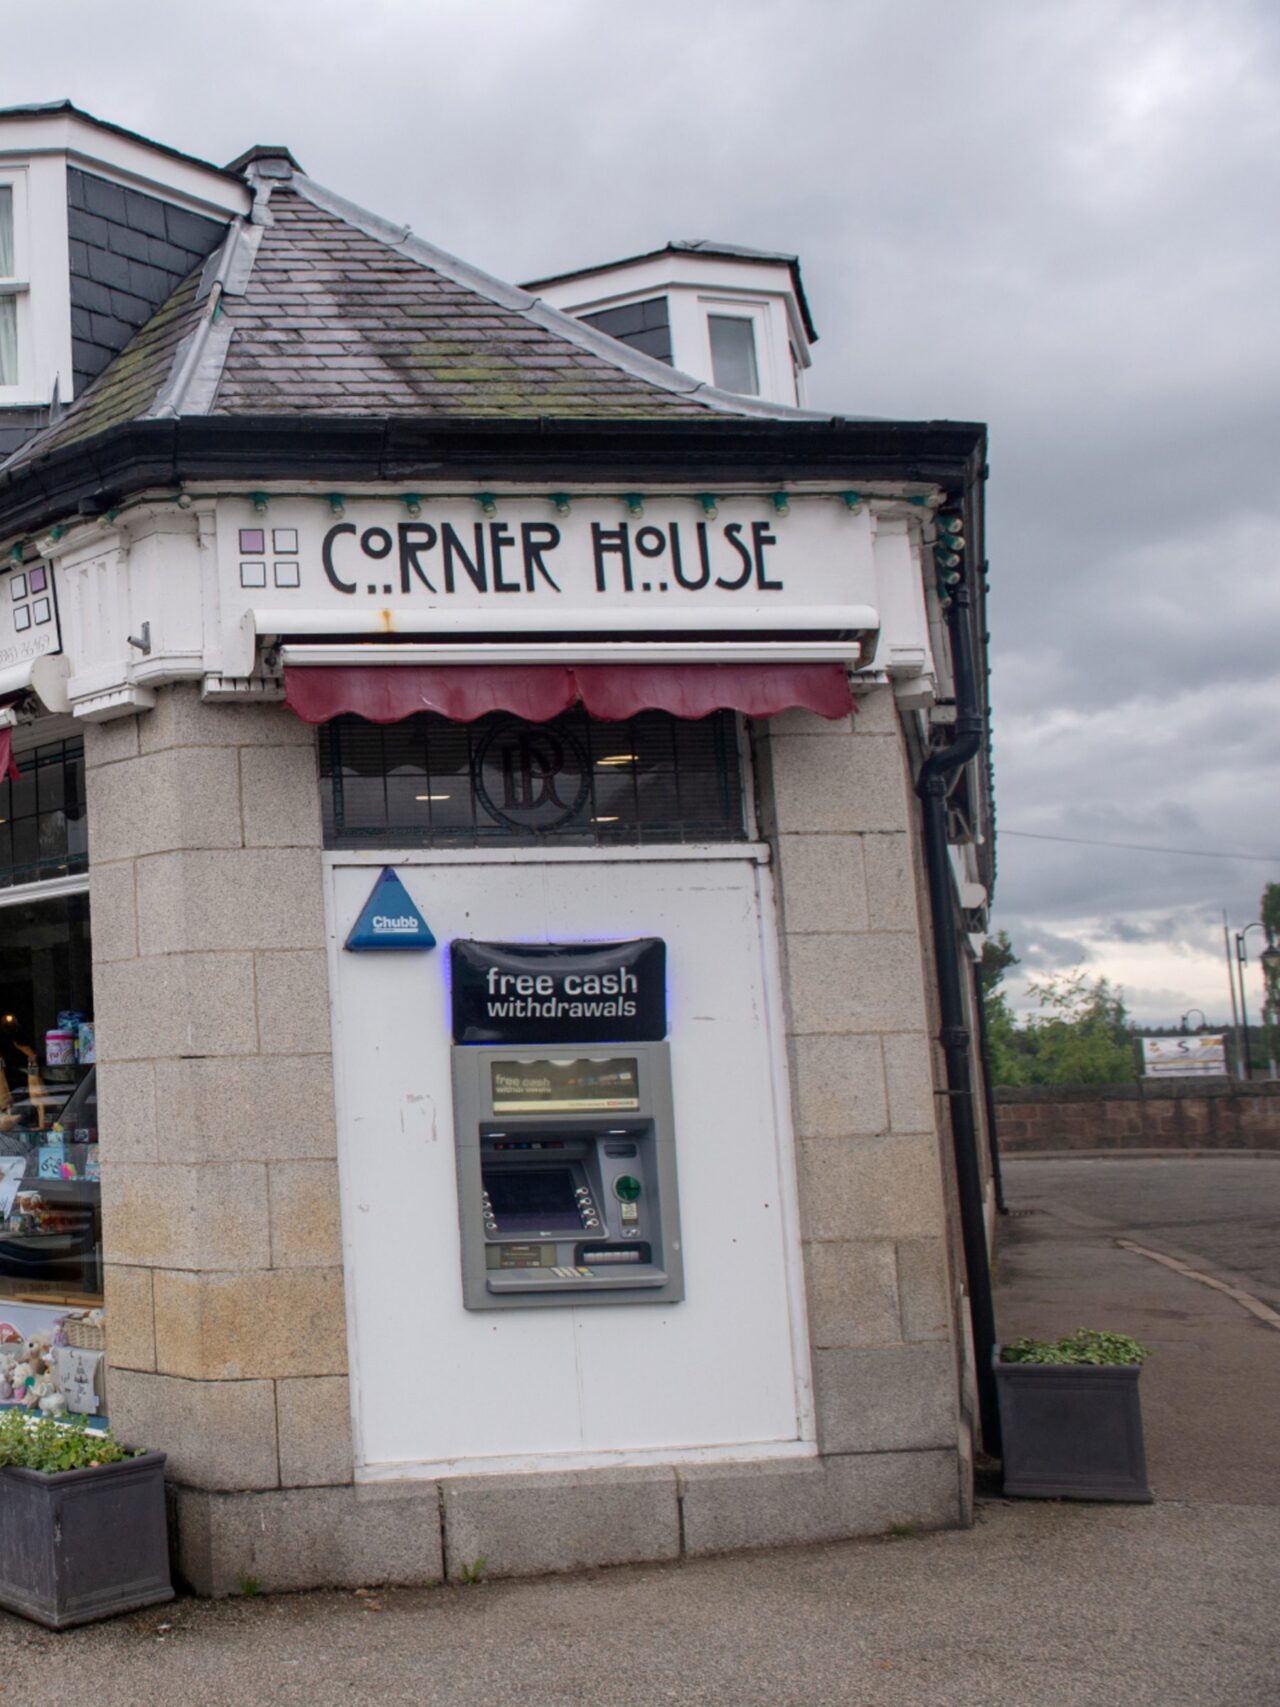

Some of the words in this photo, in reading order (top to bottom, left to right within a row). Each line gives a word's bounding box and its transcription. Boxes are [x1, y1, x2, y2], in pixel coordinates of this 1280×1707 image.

[322, 522, 562, 594] CORNER
[591, 521, 784, 592] HOUSE
[372, 916, 419, 928] Chubb
[486, 967, 554, 995] free
[564, 966, 638, 995] cash
[487, 996, 637, 1018] withdrawals
[495, 1074, 521, 1087] free
